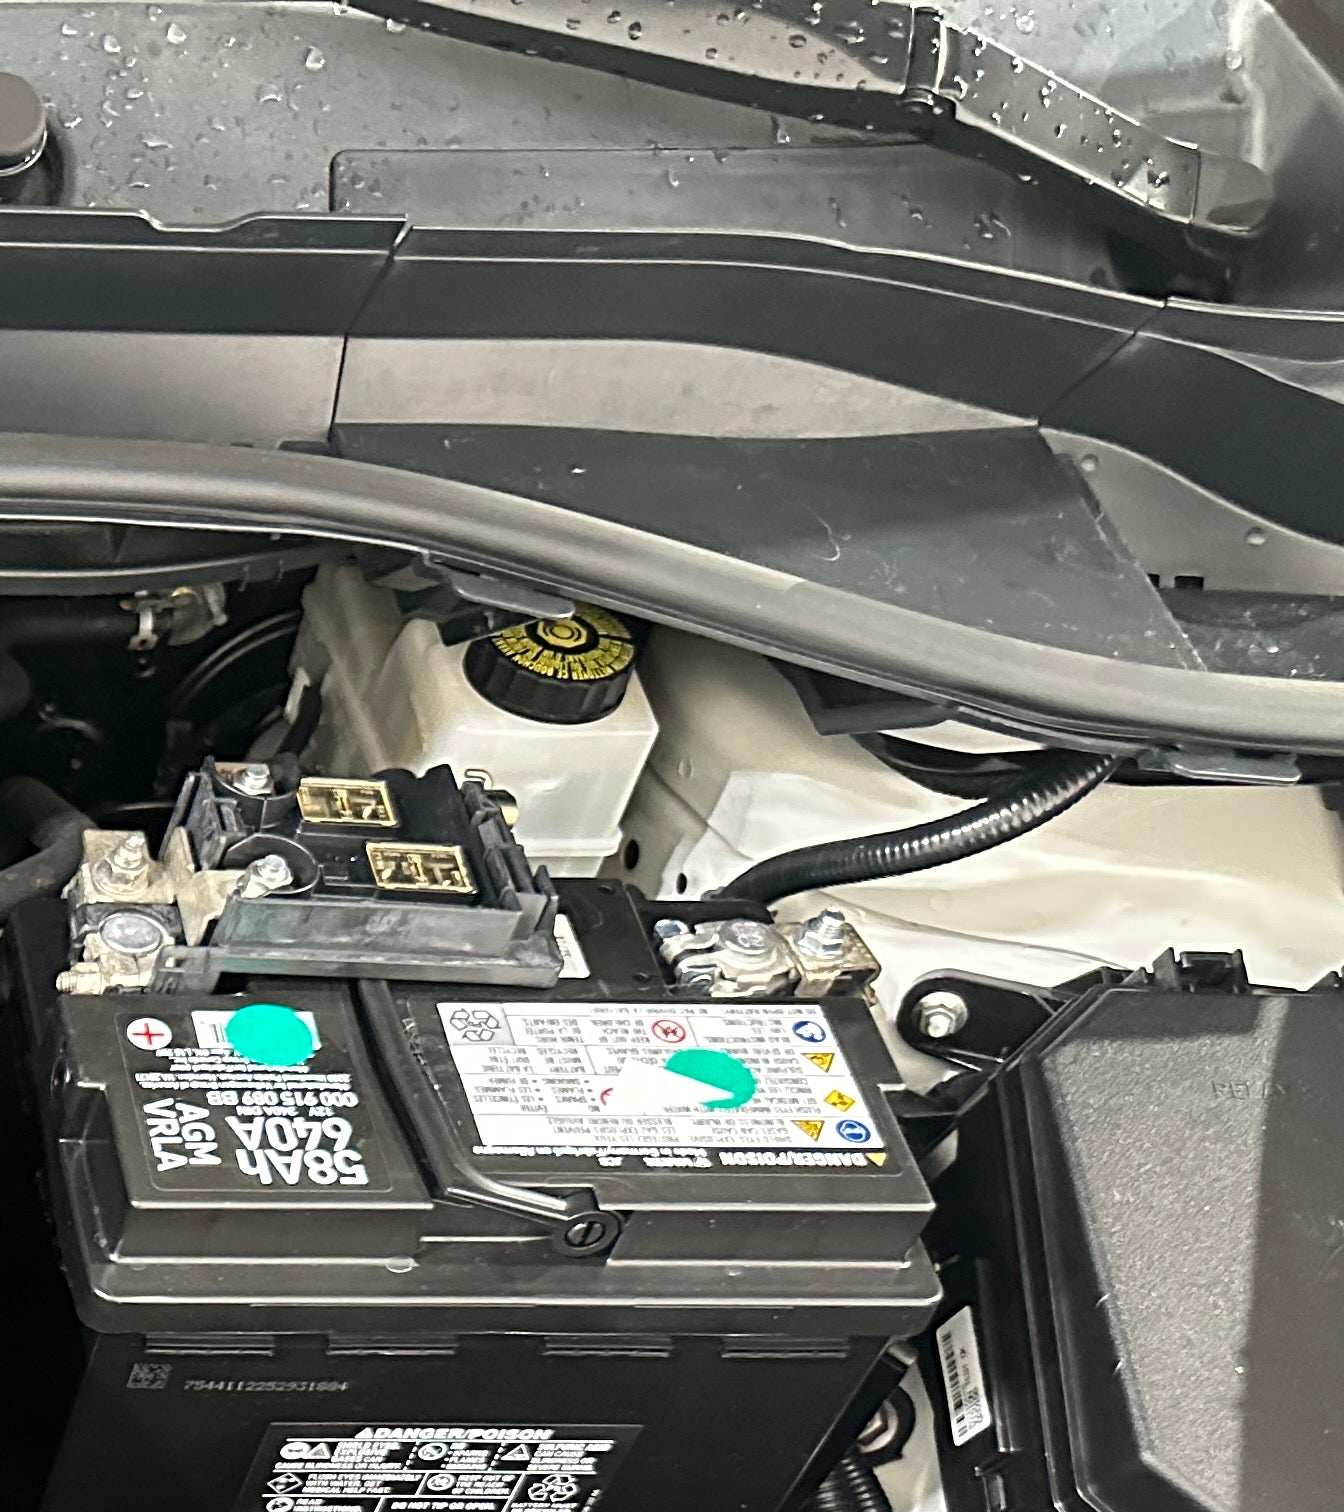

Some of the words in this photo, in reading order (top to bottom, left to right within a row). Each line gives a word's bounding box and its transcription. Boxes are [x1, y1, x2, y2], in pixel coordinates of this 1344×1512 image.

[206, 1091, 239, 1106] BB
[242, 1091, 279, 1106] 089
[281, 1091, 318, 1107] 915
[320, 1091, 359, 1108] 000
[143, 1098, 188, 1172] VRLA
[175, 1102, 222, 1165] AGM
[225, 1116, 352, 1151] 640A
[235, 1148, 368, 1185] 58Ah
[718, 1151, 867, 1166] DANGER/POISON
[373, 1427, 555, 1440] DANGER/POISON
